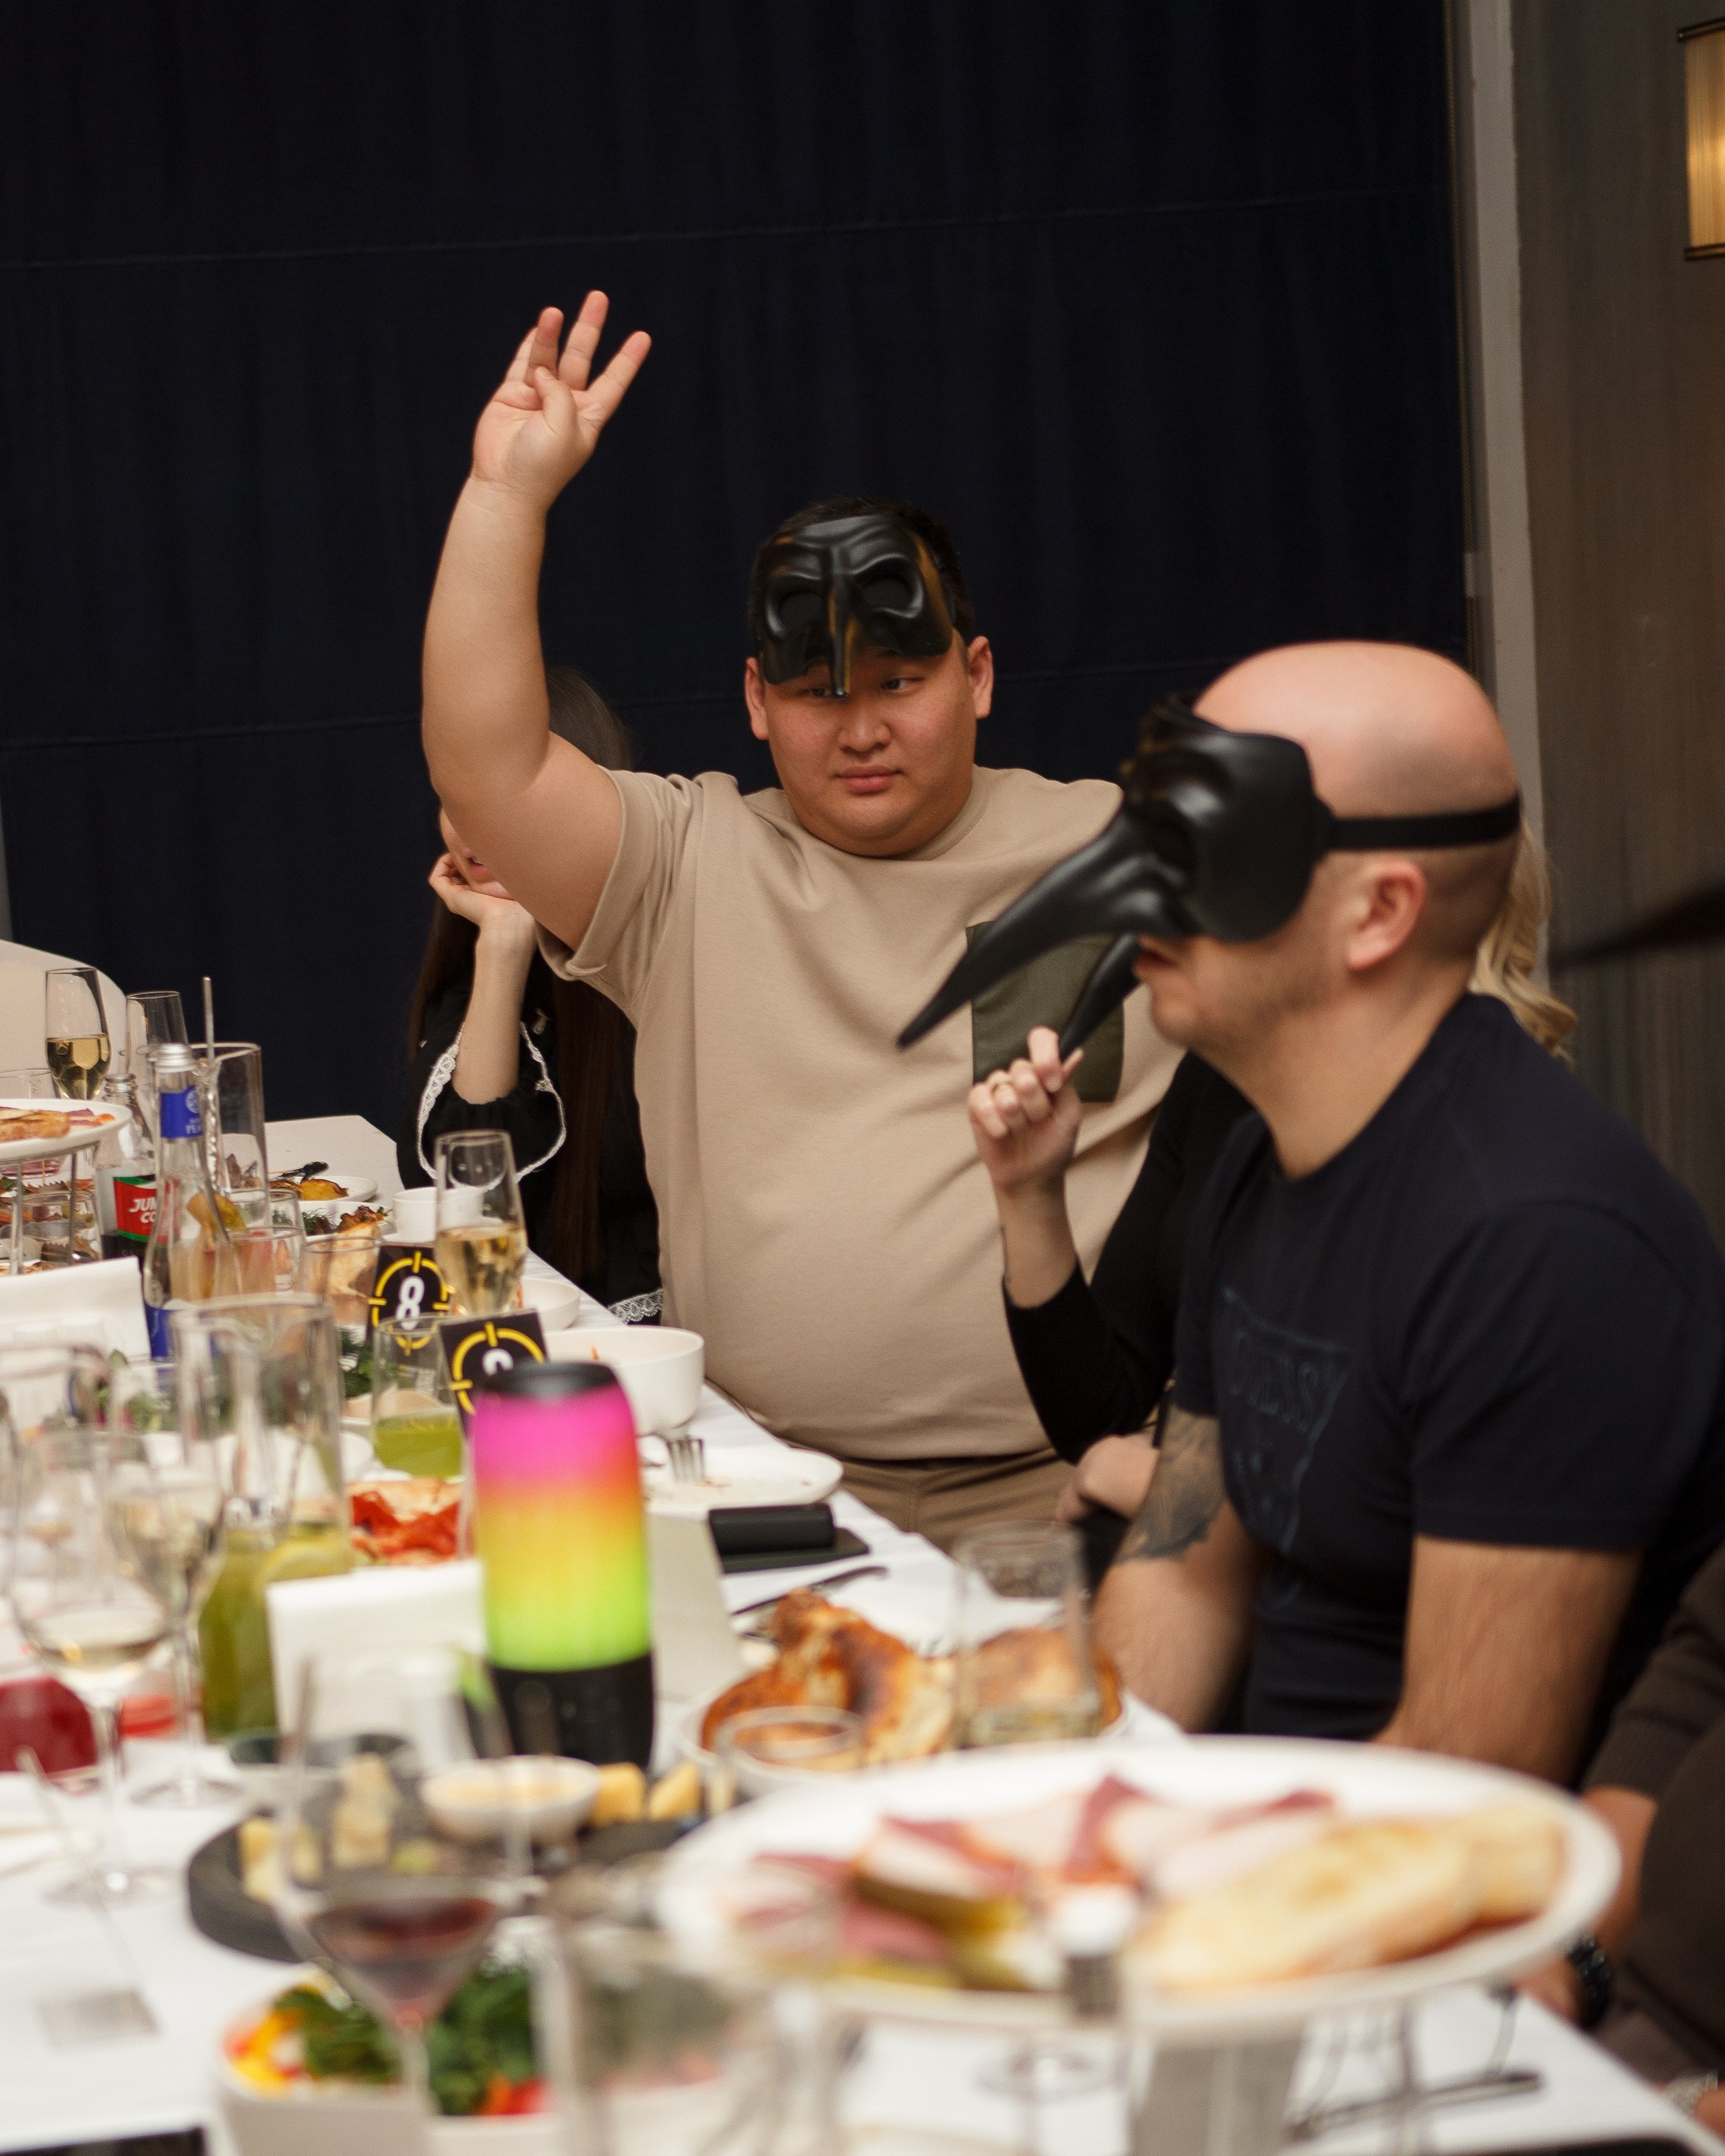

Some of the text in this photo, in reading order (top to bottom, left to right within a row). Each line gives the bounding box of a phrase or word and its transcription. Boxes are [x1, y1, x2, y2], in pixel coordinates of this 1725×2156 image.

[129, 1197, 157, 1213] JUM
[140, 1211, 157, 1224] CO
[396, 1275, 425, 1331] 8
